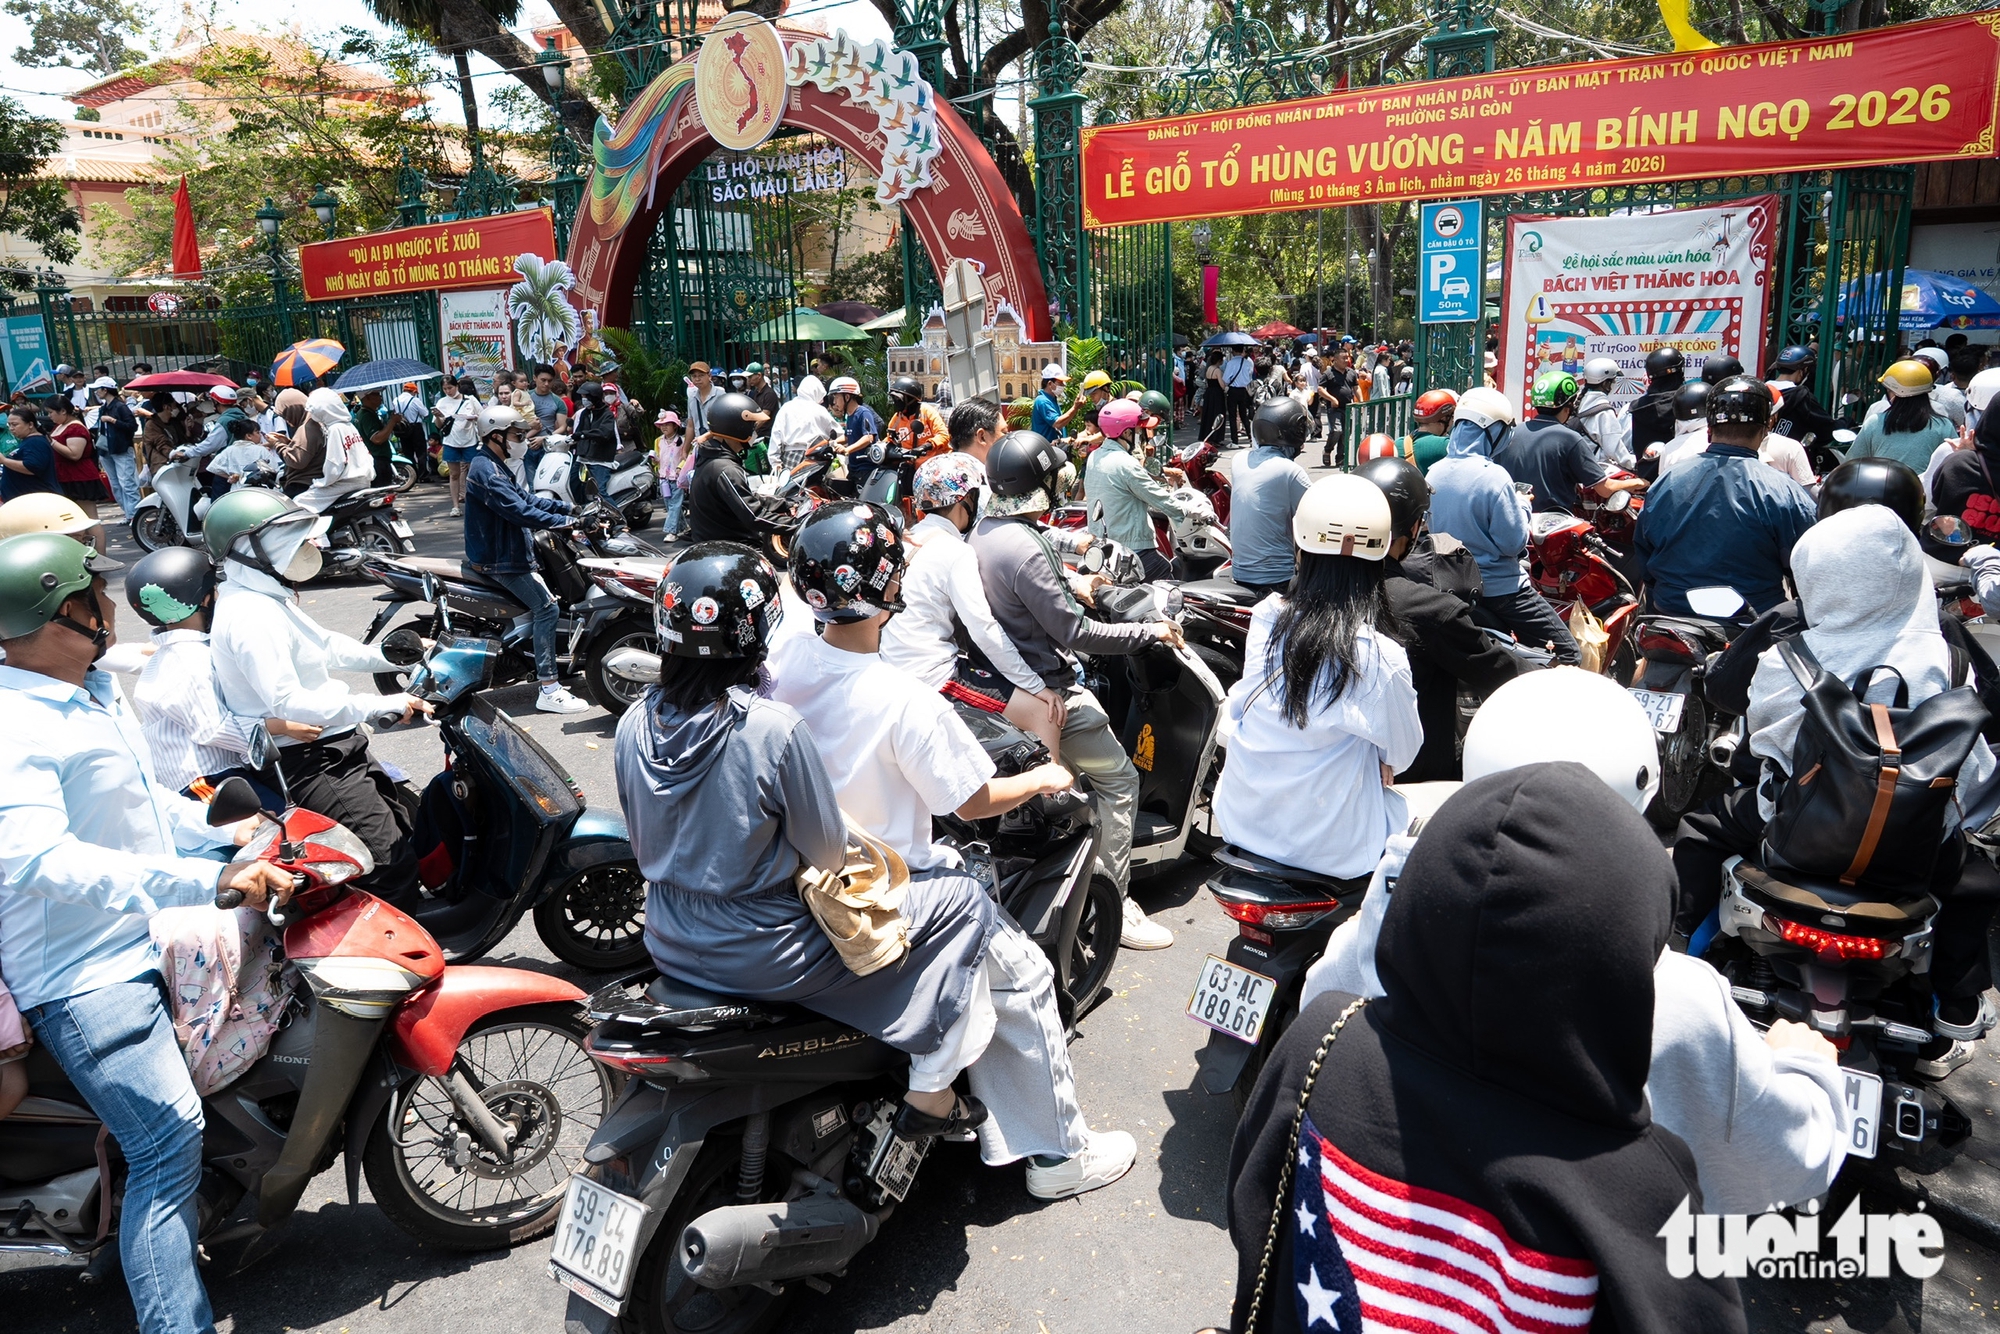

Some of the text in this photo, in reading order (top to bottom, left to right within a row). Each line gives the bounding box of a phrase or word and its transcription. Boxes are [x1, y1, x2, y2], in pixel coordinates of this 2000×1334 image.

[1210, 117, 1233, 134] HỘI
[1236, 112, 1272, 129] ĐỒNG
[1275, 107, 1312, 125] NHÂN
[1315, 101, 1345, 119] DÂN
[1381, 95, 1411, 111] BAN
[1415, 88, 1457, 107] NHÂN
[1461, 83, 1494, 101] DÂN
[1535, 79, 1570, 93] BAN
[1617, 63, 1665, 84] TRẬN
[1758, 46, 1803, 68] VIỆT
[1808, 41, 1854, 62] NAM
[1385, 99, 1513, 128] PHƯỜNG SÀI GÒN
[1105, 157, 1135, 200] LỄ
[1145, 150, 1192, 195] GIỖ
[1201, 142, 1242, 189] TỔ
[1250, 144, 1338, 184] HÙNG
[1347, 132, 1465, 174] VƯƠNG
[1494, 118, 1582, 160] NĂM
[1595, 106, 1699, 151] BÍNH
[1717, 98, 1811, 142] NGỌ
[1825, 83, 1951, 131] 2026
[750, 176, 788, 198] MÀU
[833, 171, 844, 188] 2
[1270, 188, 1304, 205] (Mùng
[1308, 184, 1324, 199] 10
[1326, 182, 1360, 198] tháng
[1365, 182, 1372, 195] 3
[1375, 174, 1396, 194] Âm
[1399, 177, 1426, 193] lịch,
[1469, 169, 1500, 188] ngày
[1504, 166, 1523, 183] 26
[1527, 163, 1567, 182] tháng
[1571, 161, 1581, 177] 4
[1585, 160, 1617, 176] năm
[1622, 154, 1665, 173] 2026)
[370, 247, 381, 262] AI
[383, 246, 394, 260] ĐI
[396, 237, 432, 259] NGƯỢC
[435, 229, 449, 253] VỀ
[452, 229, 481, 251] XUÔI
[1427, 239, 1442, 249] CẤM
[325, 272, 344, 292] NHỚ
[346, 270, 371, 290] NGÀY
[373, 262, 390, 287] GIỖ
[392, 258, 406, 285] TỔ
[409, 262, 440, 283] MÙNG
[442, 262, 456, 280] 10
[458, 255, 500, 278] THÁNG
[1430, 254, 1456, 292] P
[1562, 249, 1712, 271] Lễ hội sắc màu văn hóa
[1542, 269, 1741, 293] BÁCH VIỆT THĂNG HOA
[1438, 301, 1462, 309] 50m
[1590, 341, 1606, 353] TỪ
[1606, 342, 1636, 355] 17G00
[1615, 357, 1647, 369] KHÁC
[1242, 944, 1269, 959] HONDA
[1209, 963, 1263, 1005] 63-AC
[1195, 989, 1261, 1038] 189.66
[757, 1031, 871, 1059] AIRBLAD
[573, 1184, 629, 1244] 59-C4
[562, 1222, 626, 1286] 178.89
[591, 1289, 617, 1308] POWER
